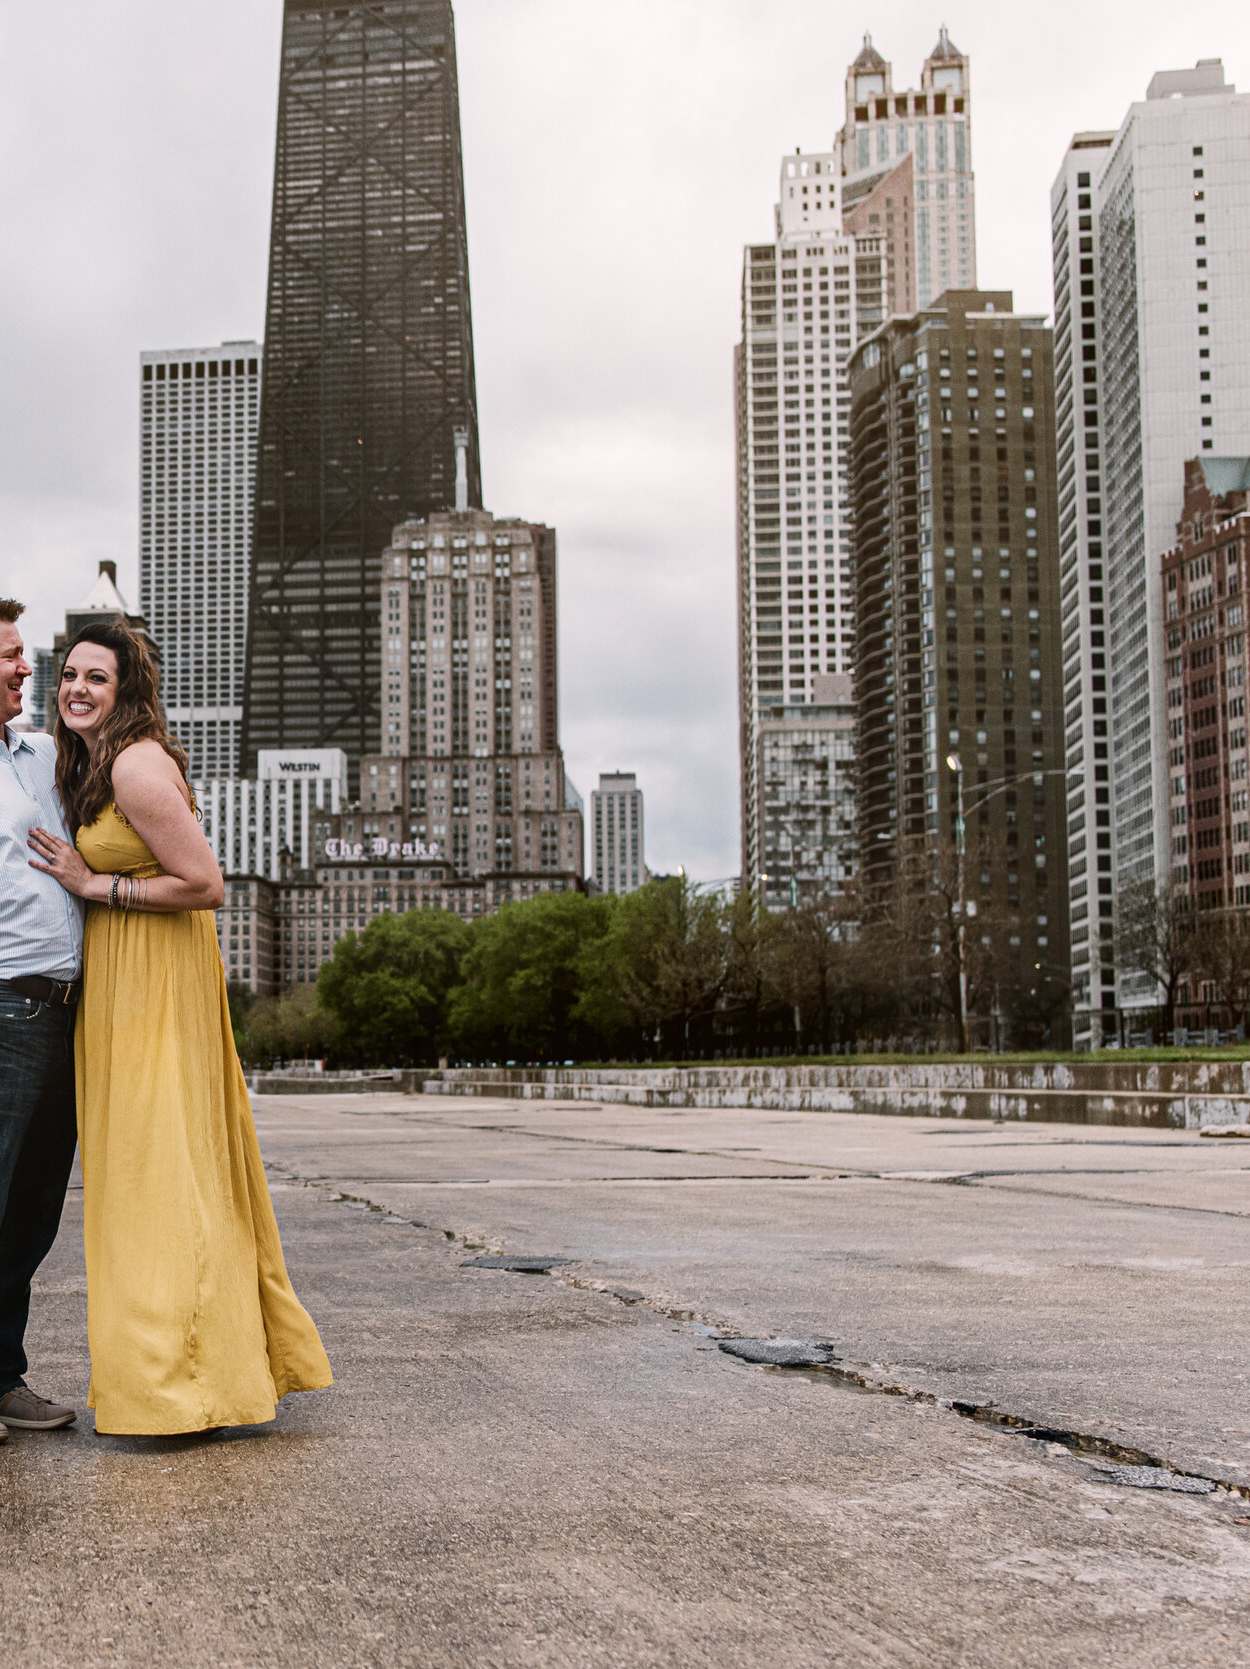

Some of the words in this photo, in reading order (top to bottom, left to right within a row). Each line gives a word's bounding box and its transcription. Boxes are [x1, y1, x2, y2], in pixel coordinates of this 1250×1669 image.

[279, 762, 320, 772] WESTIN
[324, 837, 363, 856] The
[371, 836, 439, 856] Drake
